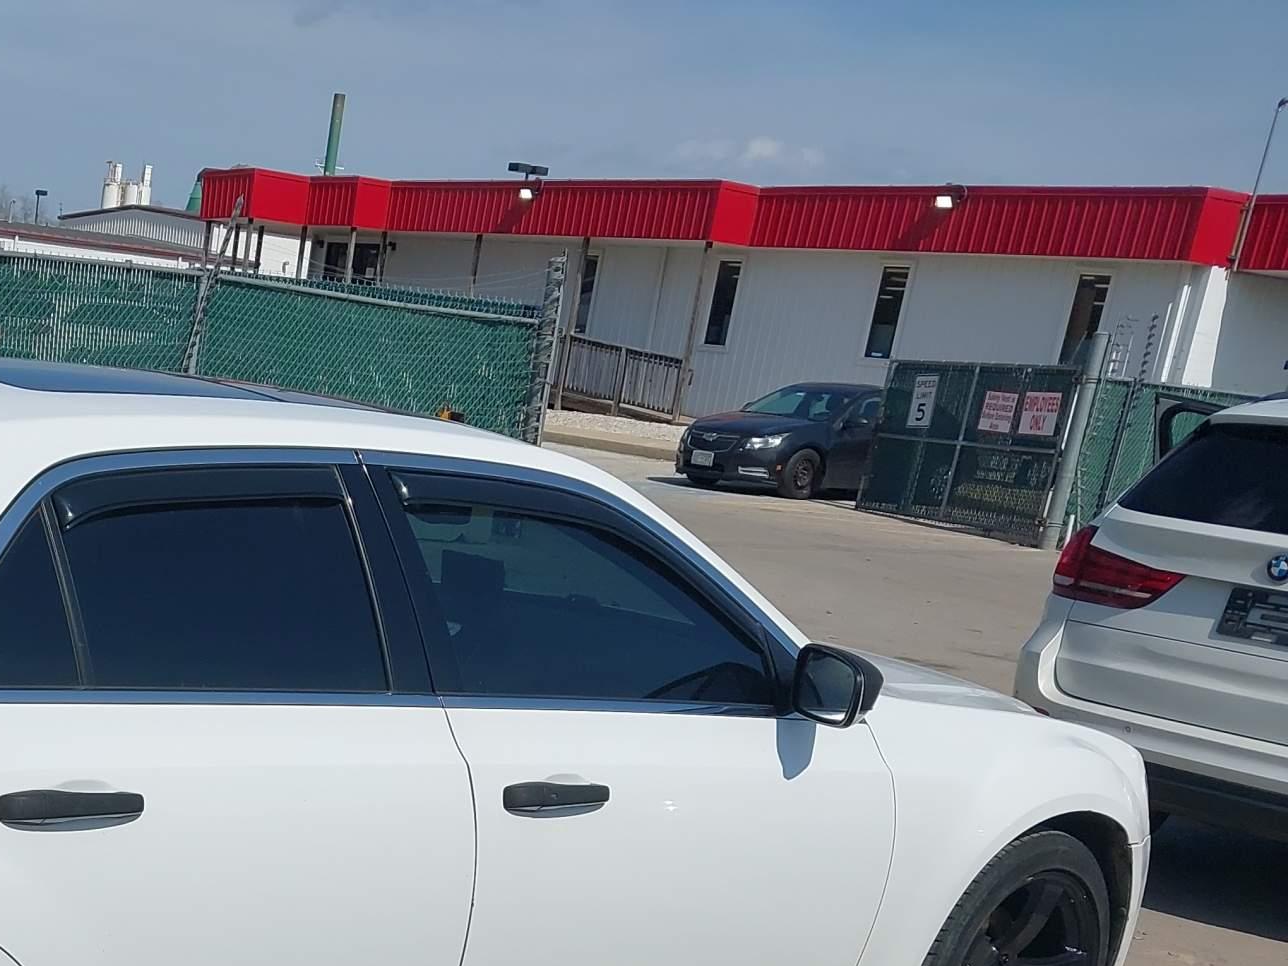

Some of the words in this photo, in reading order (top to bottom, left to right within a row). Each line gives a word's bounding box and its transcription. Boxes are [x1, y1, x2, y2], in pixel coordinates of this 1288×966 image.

[916, 380, 937, 388] SPEED
[915, 392, 932, 400] LIMIT
[1024, 396, 1060, 413] EMPLOYEES
[915, 403, 926, 421] 5
[1029, 414, 1048, 431] ONLY
